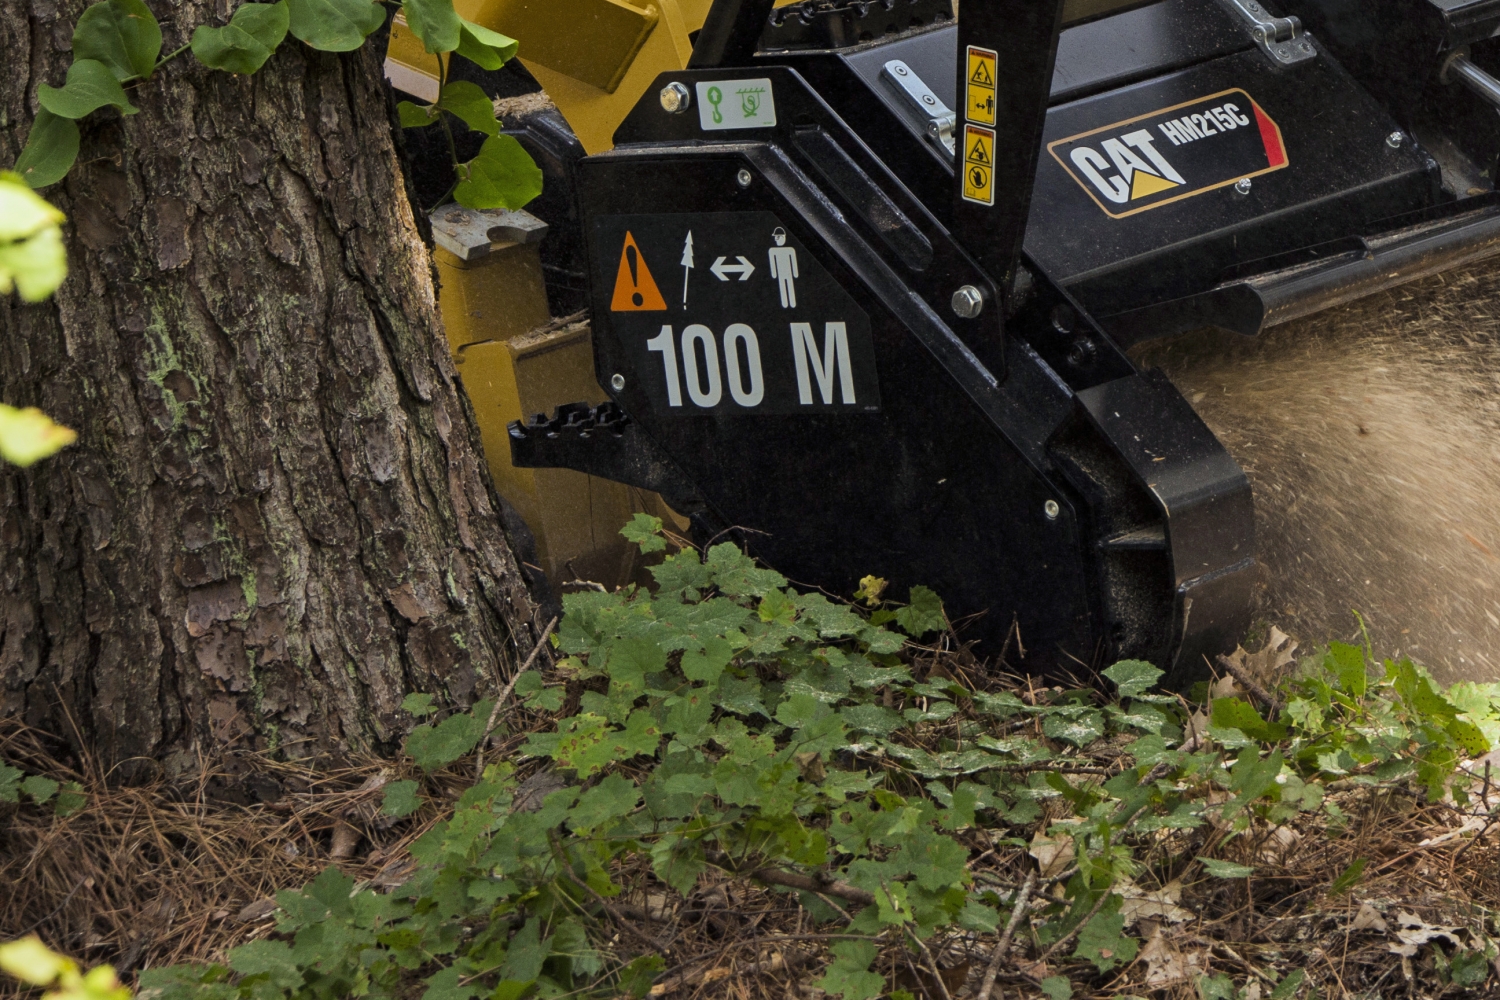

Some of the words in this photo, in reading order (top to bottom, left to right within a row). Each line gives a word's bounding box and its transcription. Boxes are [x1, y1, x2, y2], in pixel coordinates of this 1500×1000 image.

[1070, 128, 1187, 203] CAT
[1157, 102, 1250, 146] HM215C
[647, 323, 765, 408] 100
[790, 321, 856, 405] M
